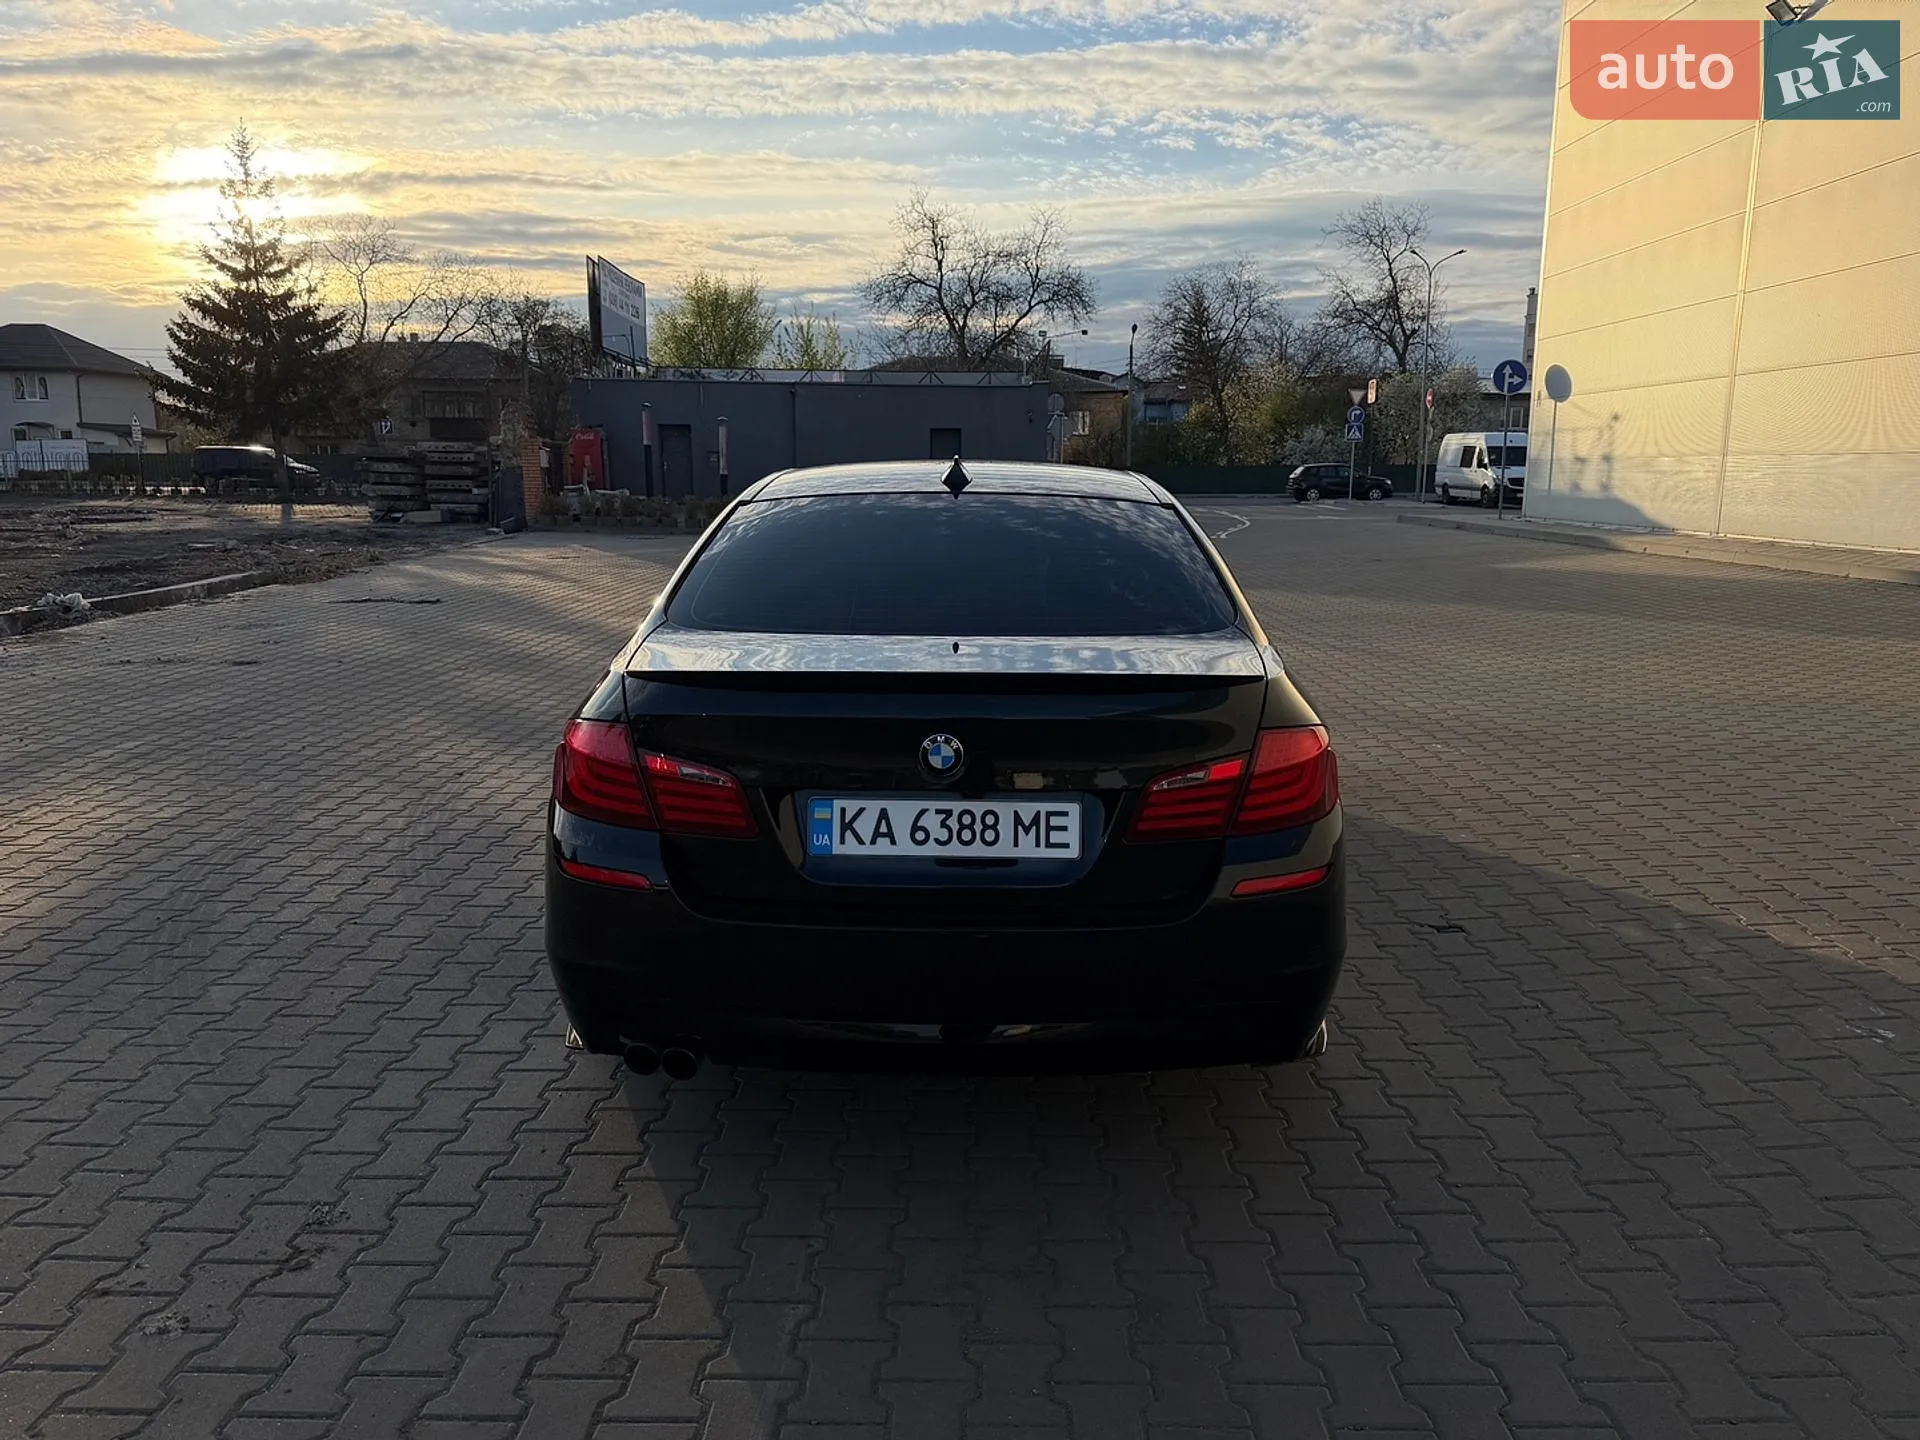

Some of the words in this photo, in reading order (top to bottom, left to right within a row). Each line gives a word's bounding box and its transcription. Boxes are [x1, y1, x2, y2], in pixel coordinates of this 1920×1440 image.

[813, 834, 830, 846] UA
[839, 807, 897, 846] KA
[909, 808, 1000, 847] 6388
[1013, 810, 1070, 849] ME
